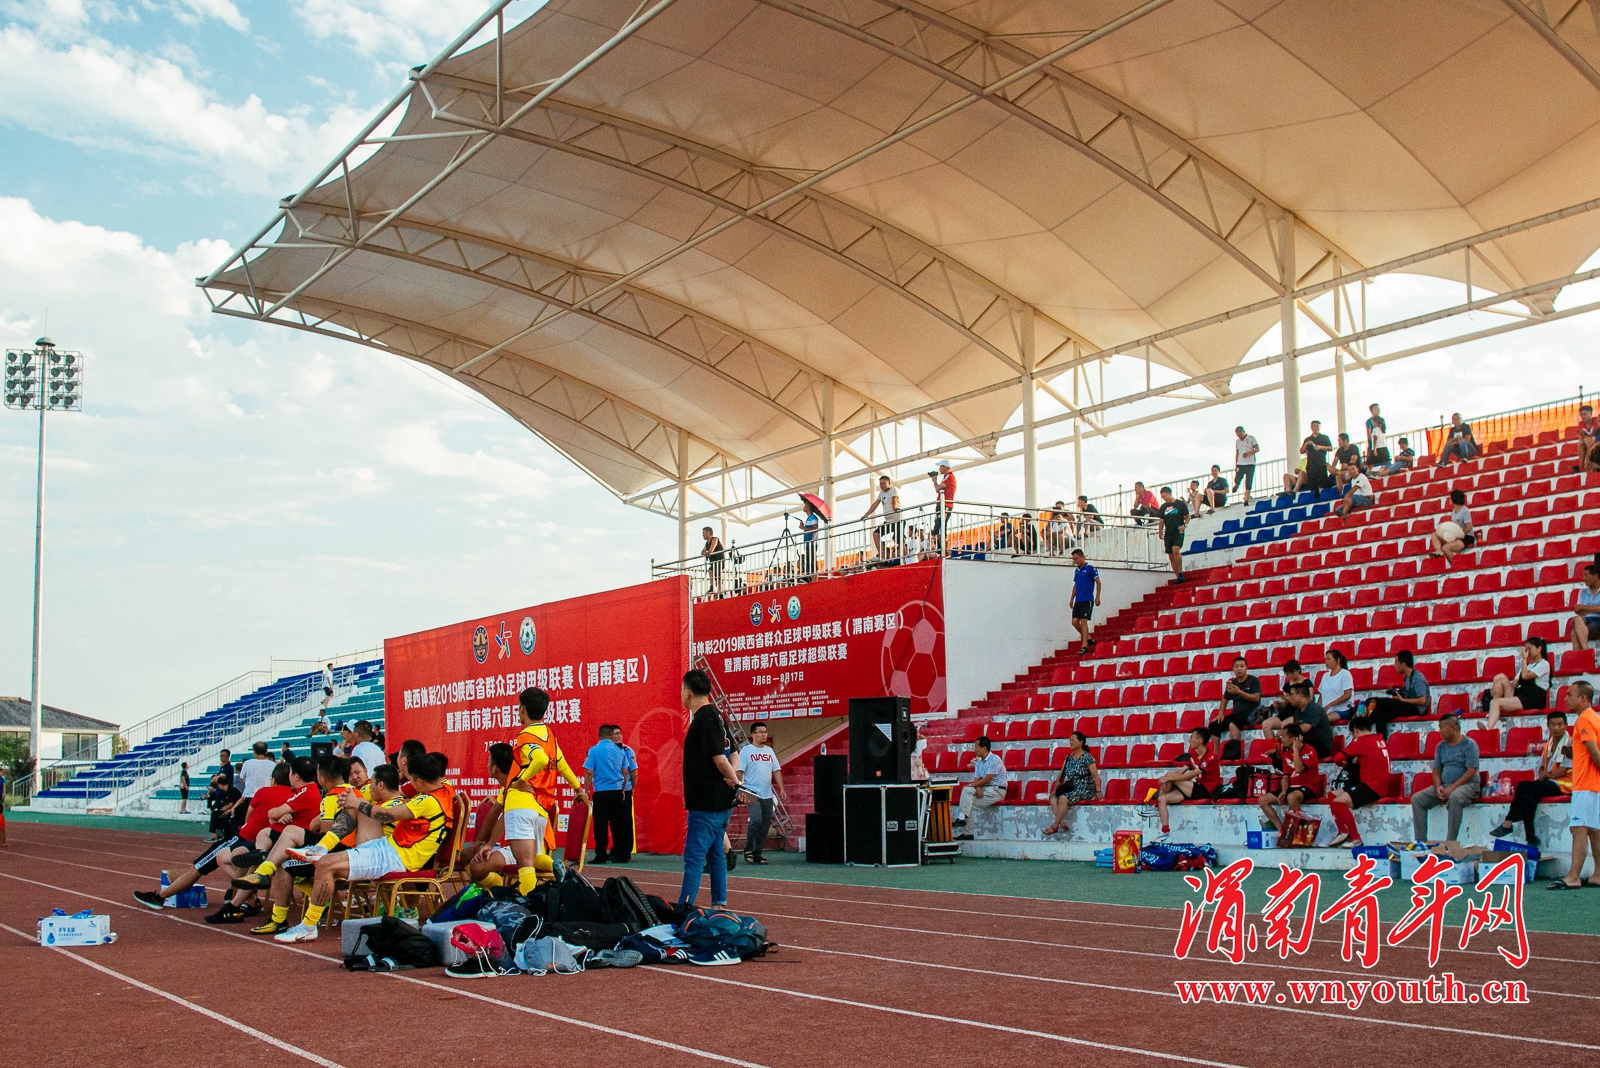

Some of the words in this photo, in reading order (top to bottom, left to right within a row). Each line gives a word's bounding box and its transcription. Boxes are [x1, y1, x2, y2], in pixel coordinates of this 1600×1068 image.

[724, 643, 848, 673] 暨渭南市第六届足球超级联赛
[446, 698, 581, 733] 暨渭南市第六届足级联赛
[750, 753, 773, 762] NASA
